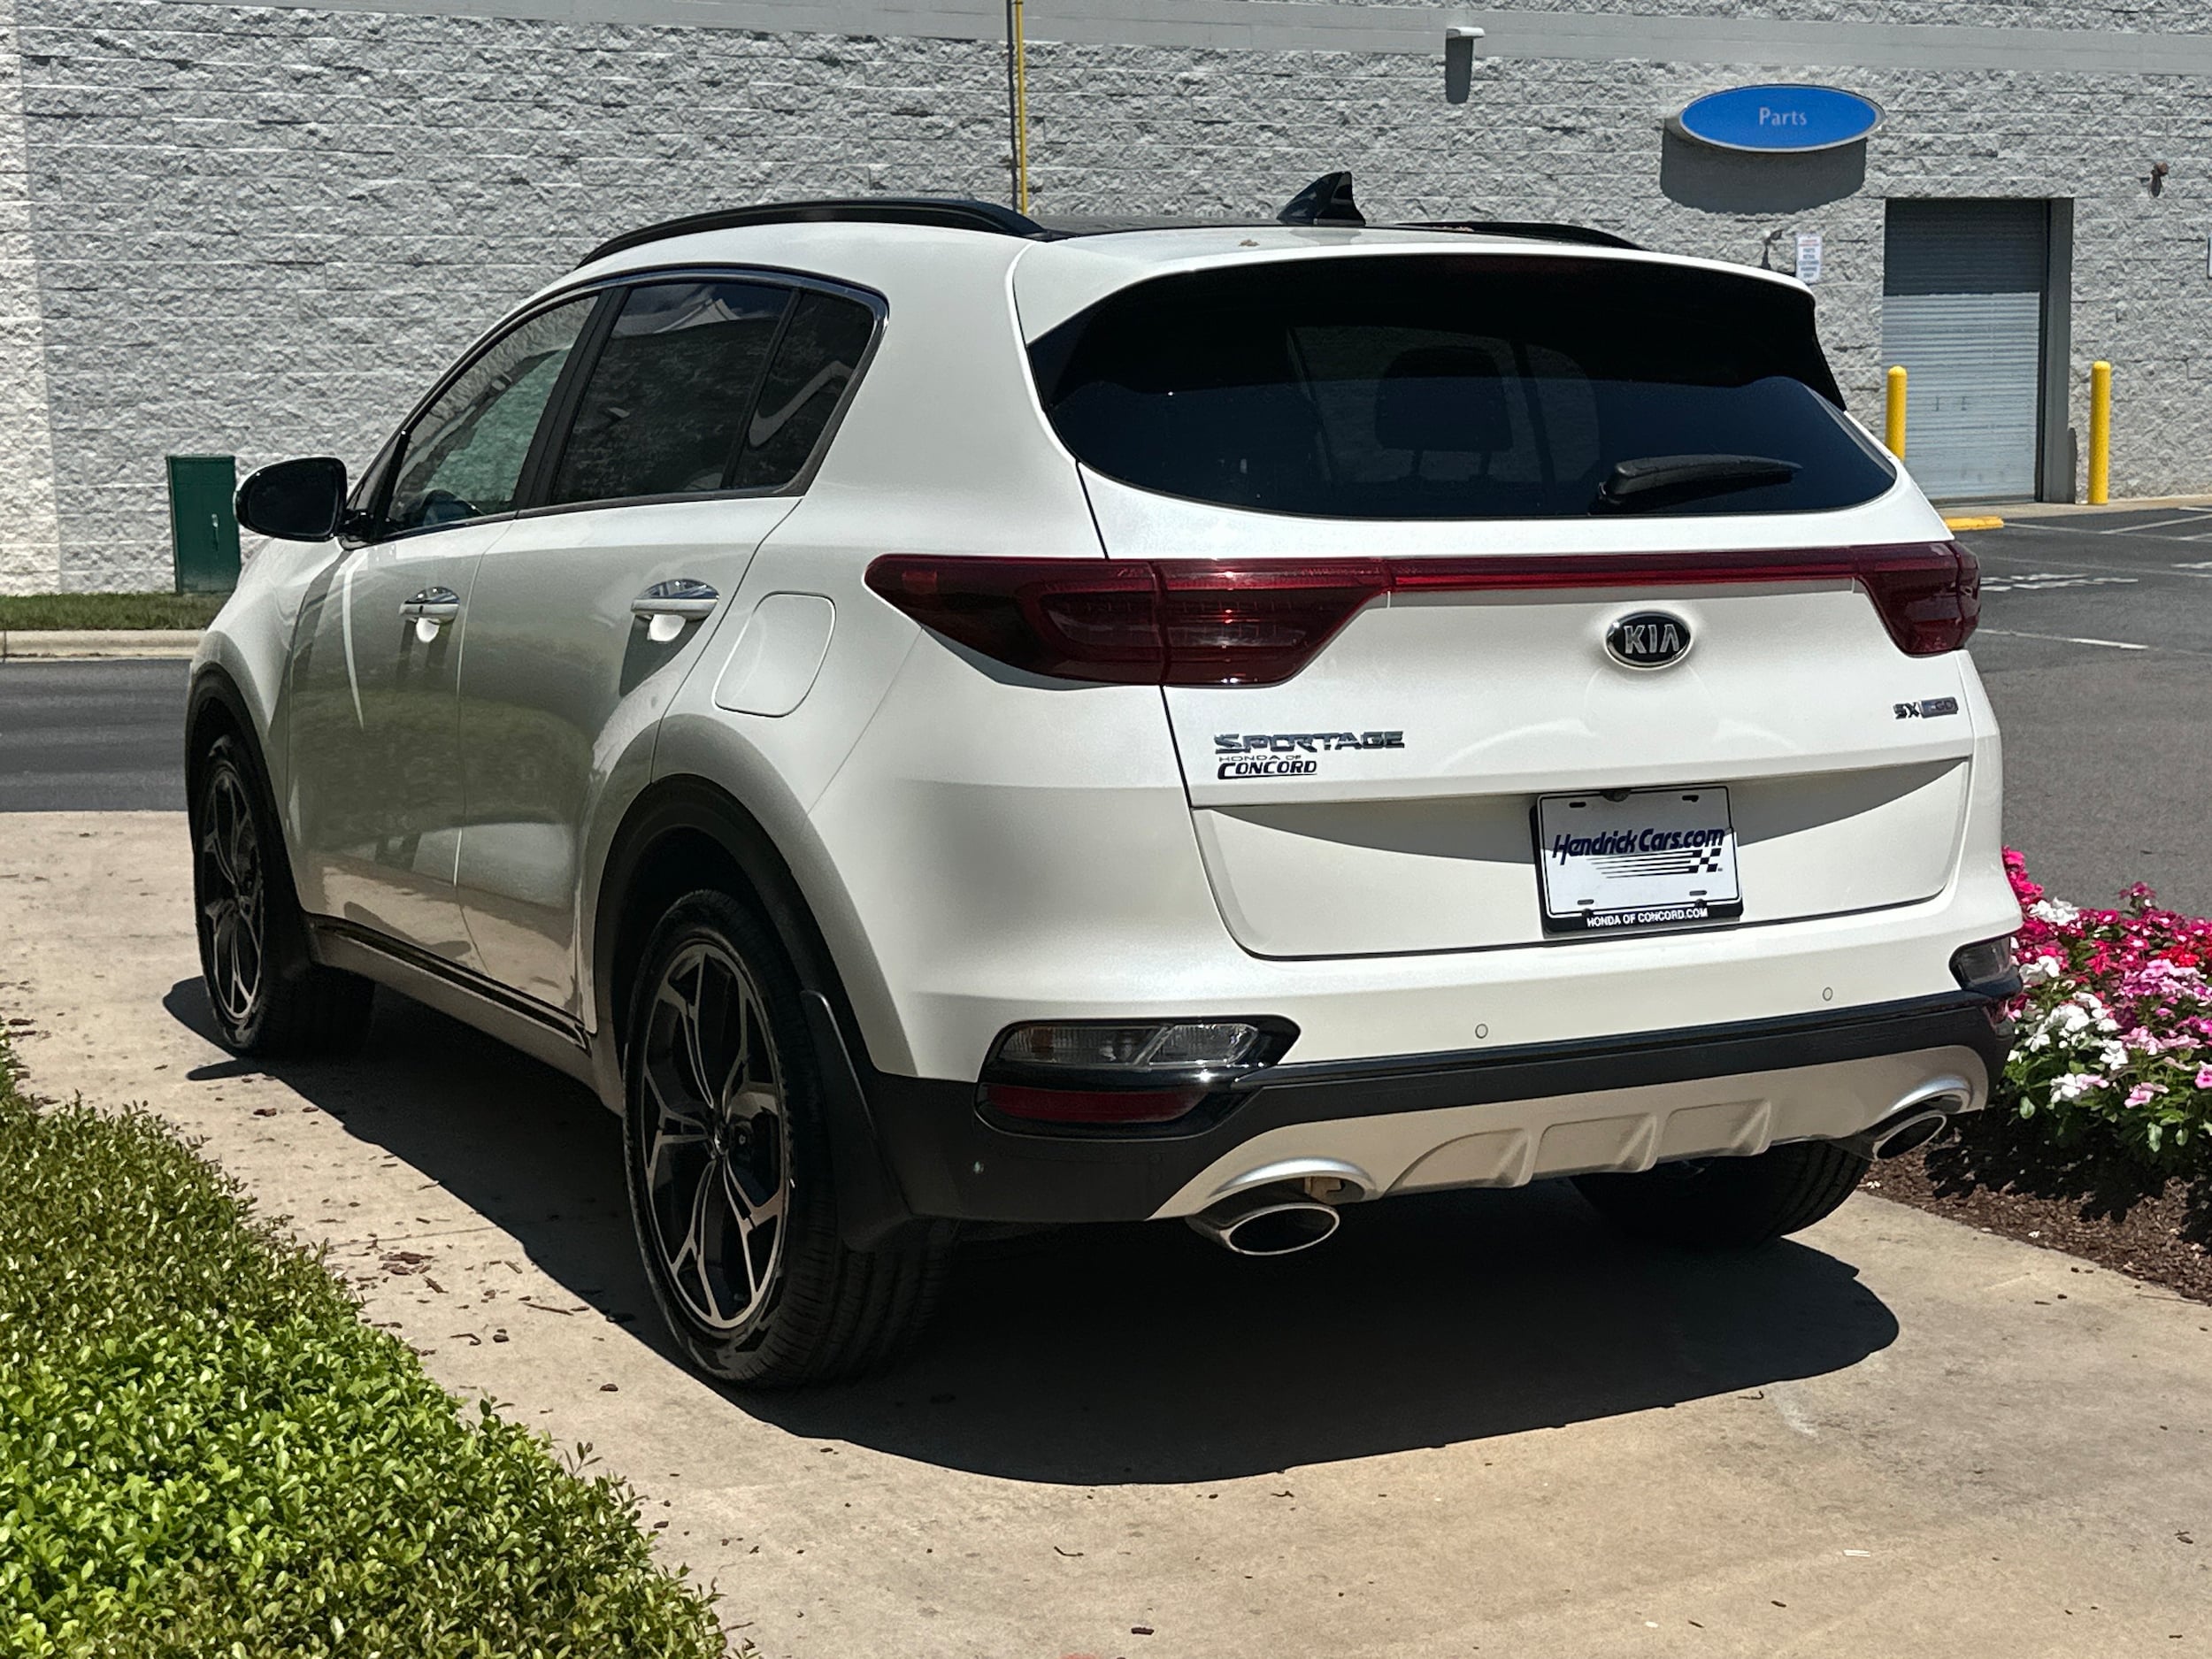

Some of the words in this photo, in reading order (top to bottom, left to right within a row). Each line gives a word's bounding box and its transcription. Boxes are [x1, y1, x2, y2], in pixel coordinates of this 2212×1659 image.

[1758, 106, 1807, 127] Parts
[1623, 624, 1680, 654] KIA
[1893, 702, 1920, 719] SX
[1214, 731, 1405, 754] SPORTAGE
[1217, 760, 1317, 780] CONCORD
[1586, 915, 1621, 927] HONDA
[1623, 913, 1636, 925] OF
[1638, 908, 1709, 922] CONCORD.COM
